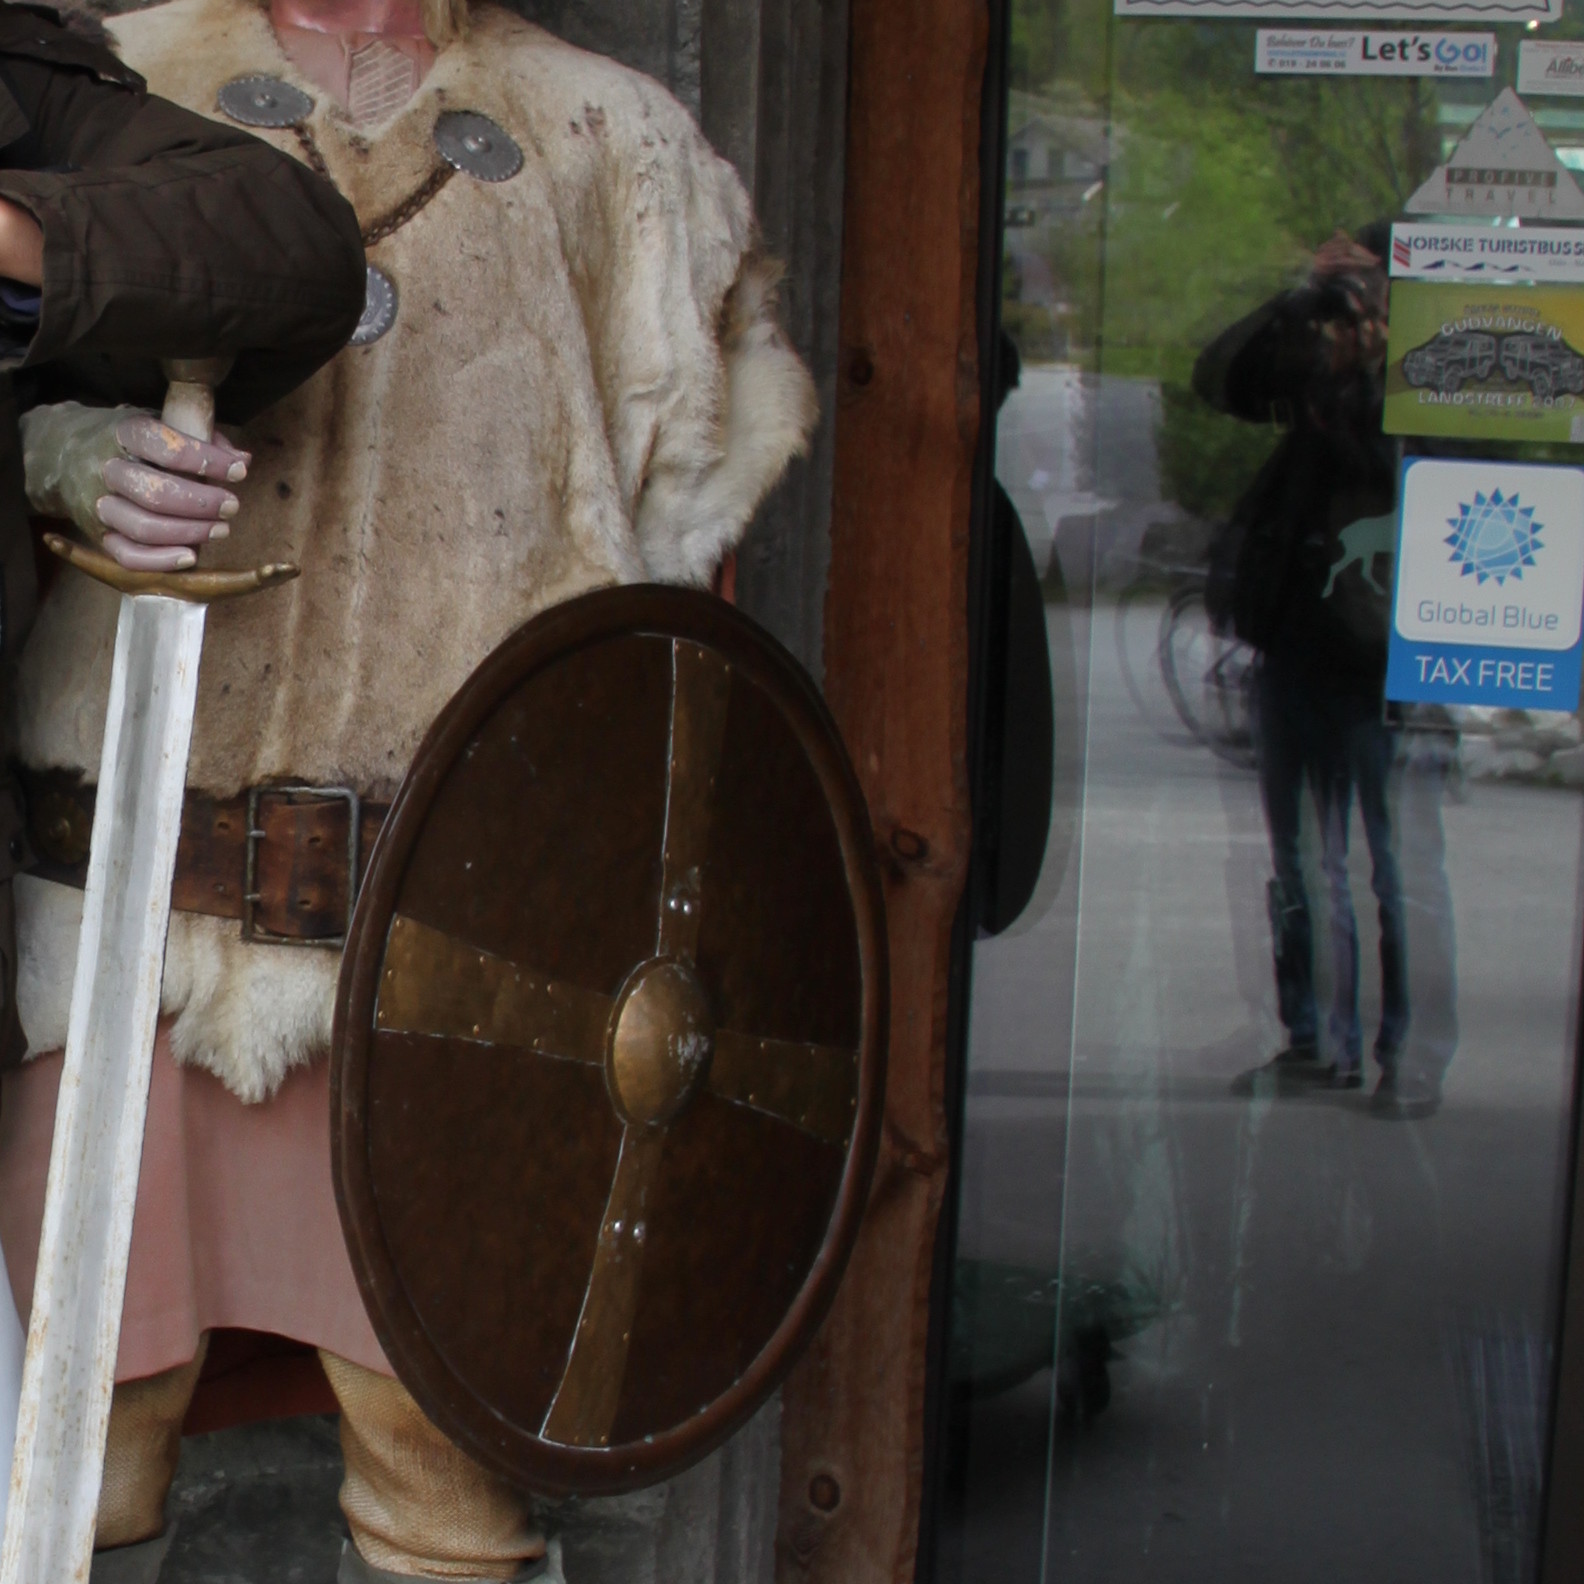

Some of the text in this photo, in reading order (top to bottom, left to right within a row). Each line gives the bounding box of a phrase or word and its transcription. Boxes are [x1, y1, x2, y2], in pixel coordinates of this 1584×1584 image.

[1362, 36, 1431, 61] Let's
[1446, 187, 1555, 204] TRAVEL
[1394, 236, 1584, 256] NORSKE TURISTBUSS
[1441, 316, 1563, 341] GUDVANGEN
[1418, 600, 1559, 630] Global Blue
[1415, 655, 1554, 691] TAX FREE
